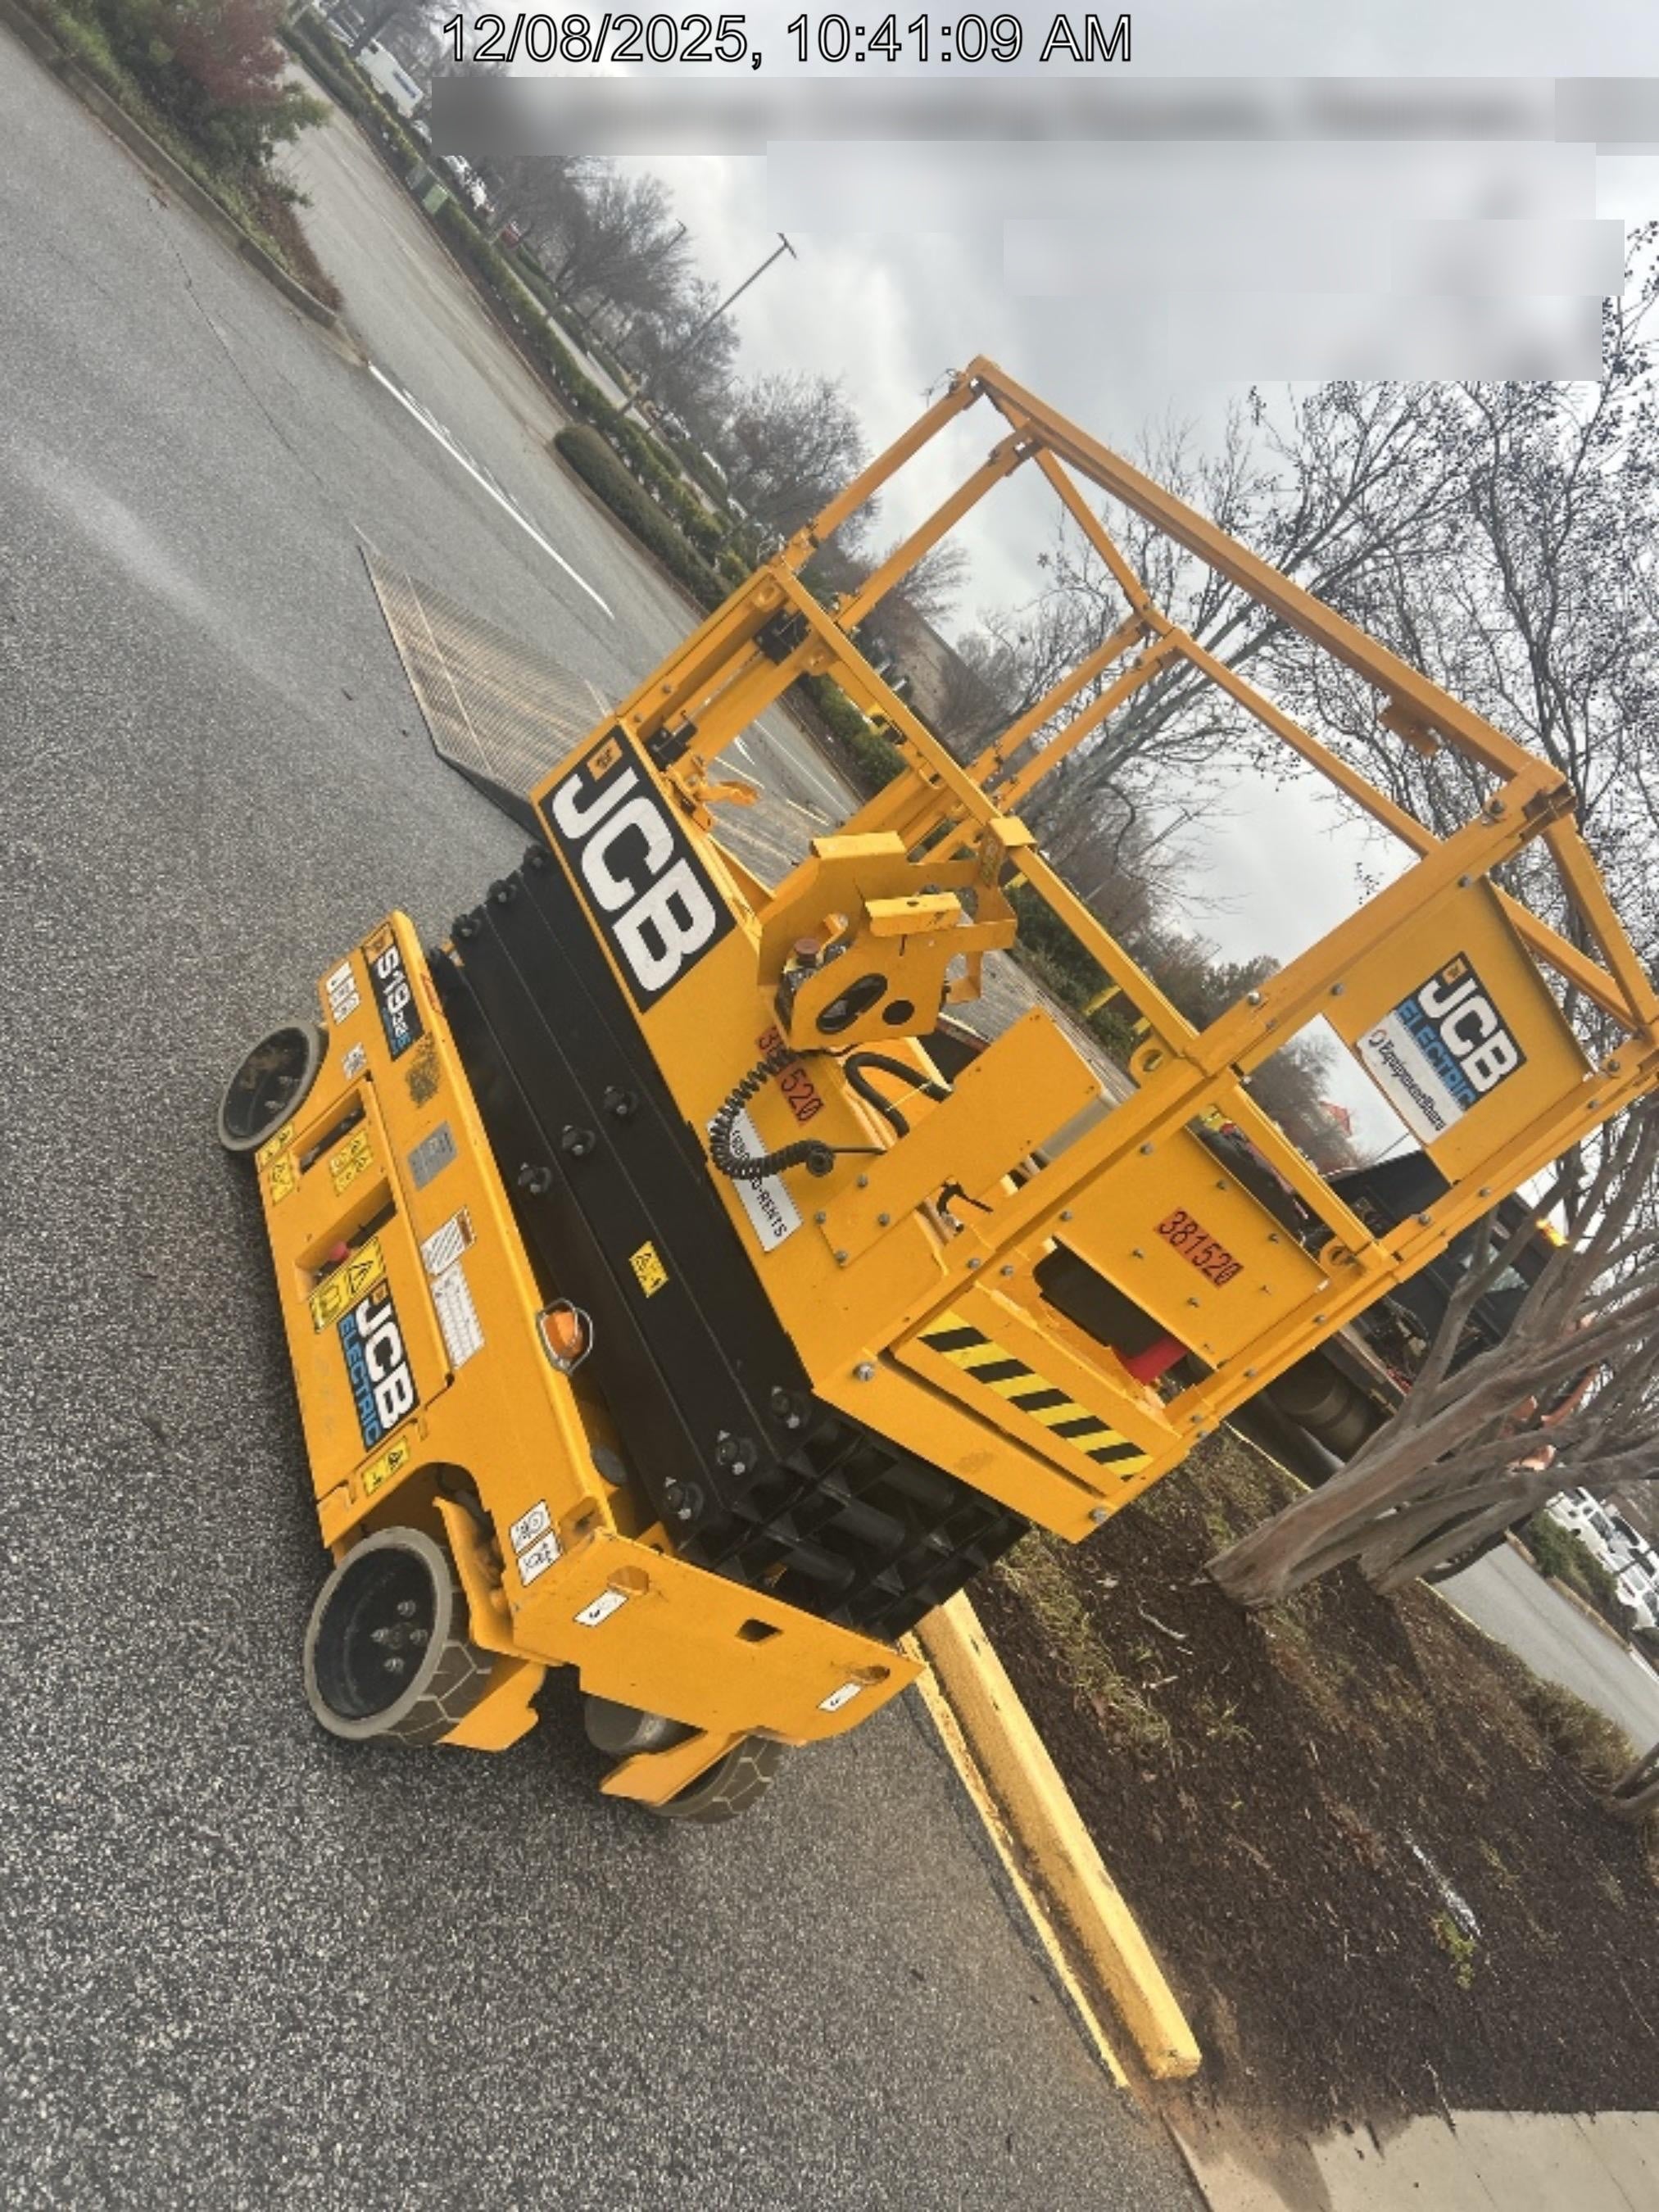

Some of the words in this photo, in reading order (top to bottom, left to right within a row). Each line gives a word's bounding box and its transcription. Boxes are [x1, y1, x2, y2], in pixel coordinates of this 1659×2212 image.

[551, 767, 716, 991] JCB
[1396, 999, 1477, 1110] ELECTRIC
[1418, 978, 1517, 1092] JCB
[1158, 1211, 1244, 1286] 381520
[338, 1314, 382, 1445] ELECTRIC
[356, 1298, 414, 1430] JCB
